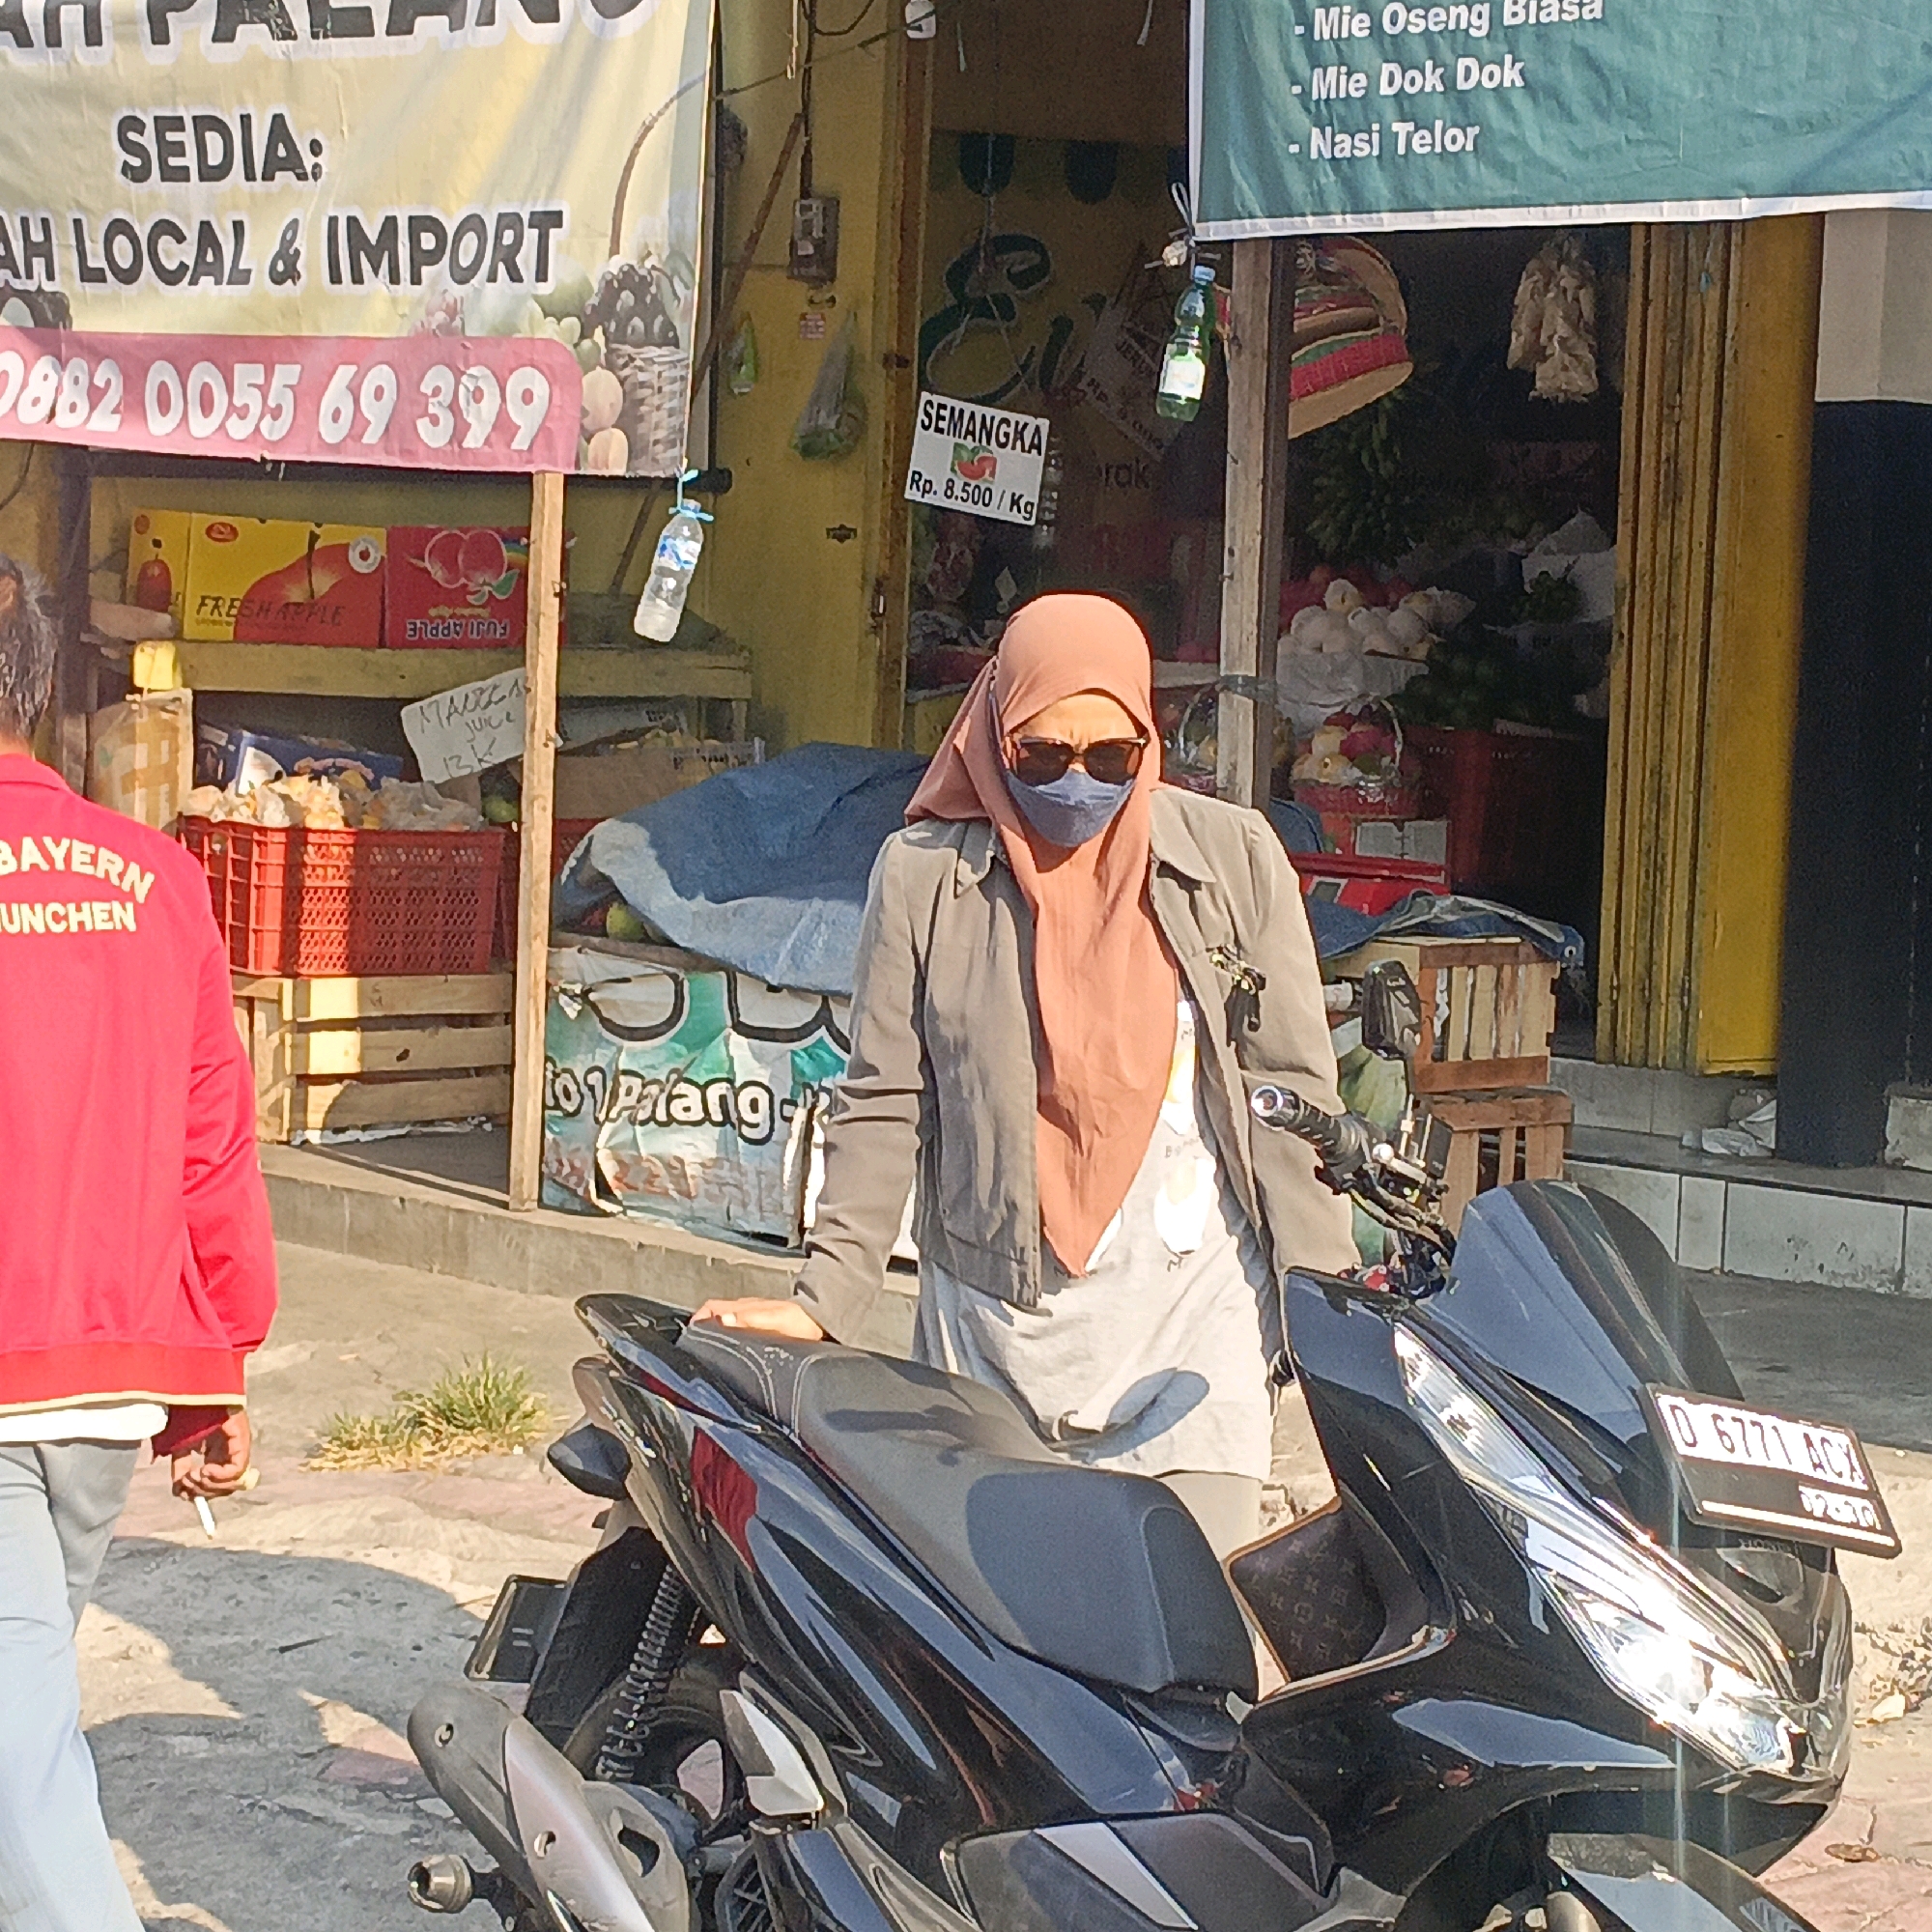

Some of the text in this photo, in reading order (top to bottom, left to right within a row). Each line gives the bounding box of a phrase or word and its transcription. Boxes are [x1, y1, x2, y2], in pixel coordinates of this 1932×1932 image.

[1313, 6, 1371, 41] Mie
[1382, 2, 1491, 38] Oseng
[1503, 0, 1603, 26] Biasa
[1312, 66, 1368, 100] Mie
[1379, 60, 1445, 96] Dok
[1457, 54, 1525, 90] Dok
[117, 113, 324, 184] SEDIA:
[1310, 123, 1379, 159] Nasi
[1392, 120, 1480, 156] Telor
[72, 217, 252, 286] LOCAL
[269, 217, 301, 286] &
[327, 210, 563, 286] IMPORT
[0, 350, 551, 451] 0882 0055 69 399
[921, 399, 1042, 456] SEMANGKA
[909, 469, 938, 498] Rp.
[943, 477, 993, 508] 8.500
[1009, 492, 1036, 522] Kg
[195, 595, 272, 620] FRESH
[276, 601, 347, 627] APPLE
[406, 618, 510, 639] FUJI APPLE
[0, 836, 156, 904] BAYERN
[0, 900, 137, 934] UNCHEN
[608, 1066, 774, 1146] Palang
[1669, 1404, 1699, 1448] D
[1711, 1412, 1793, 1466] 6771
